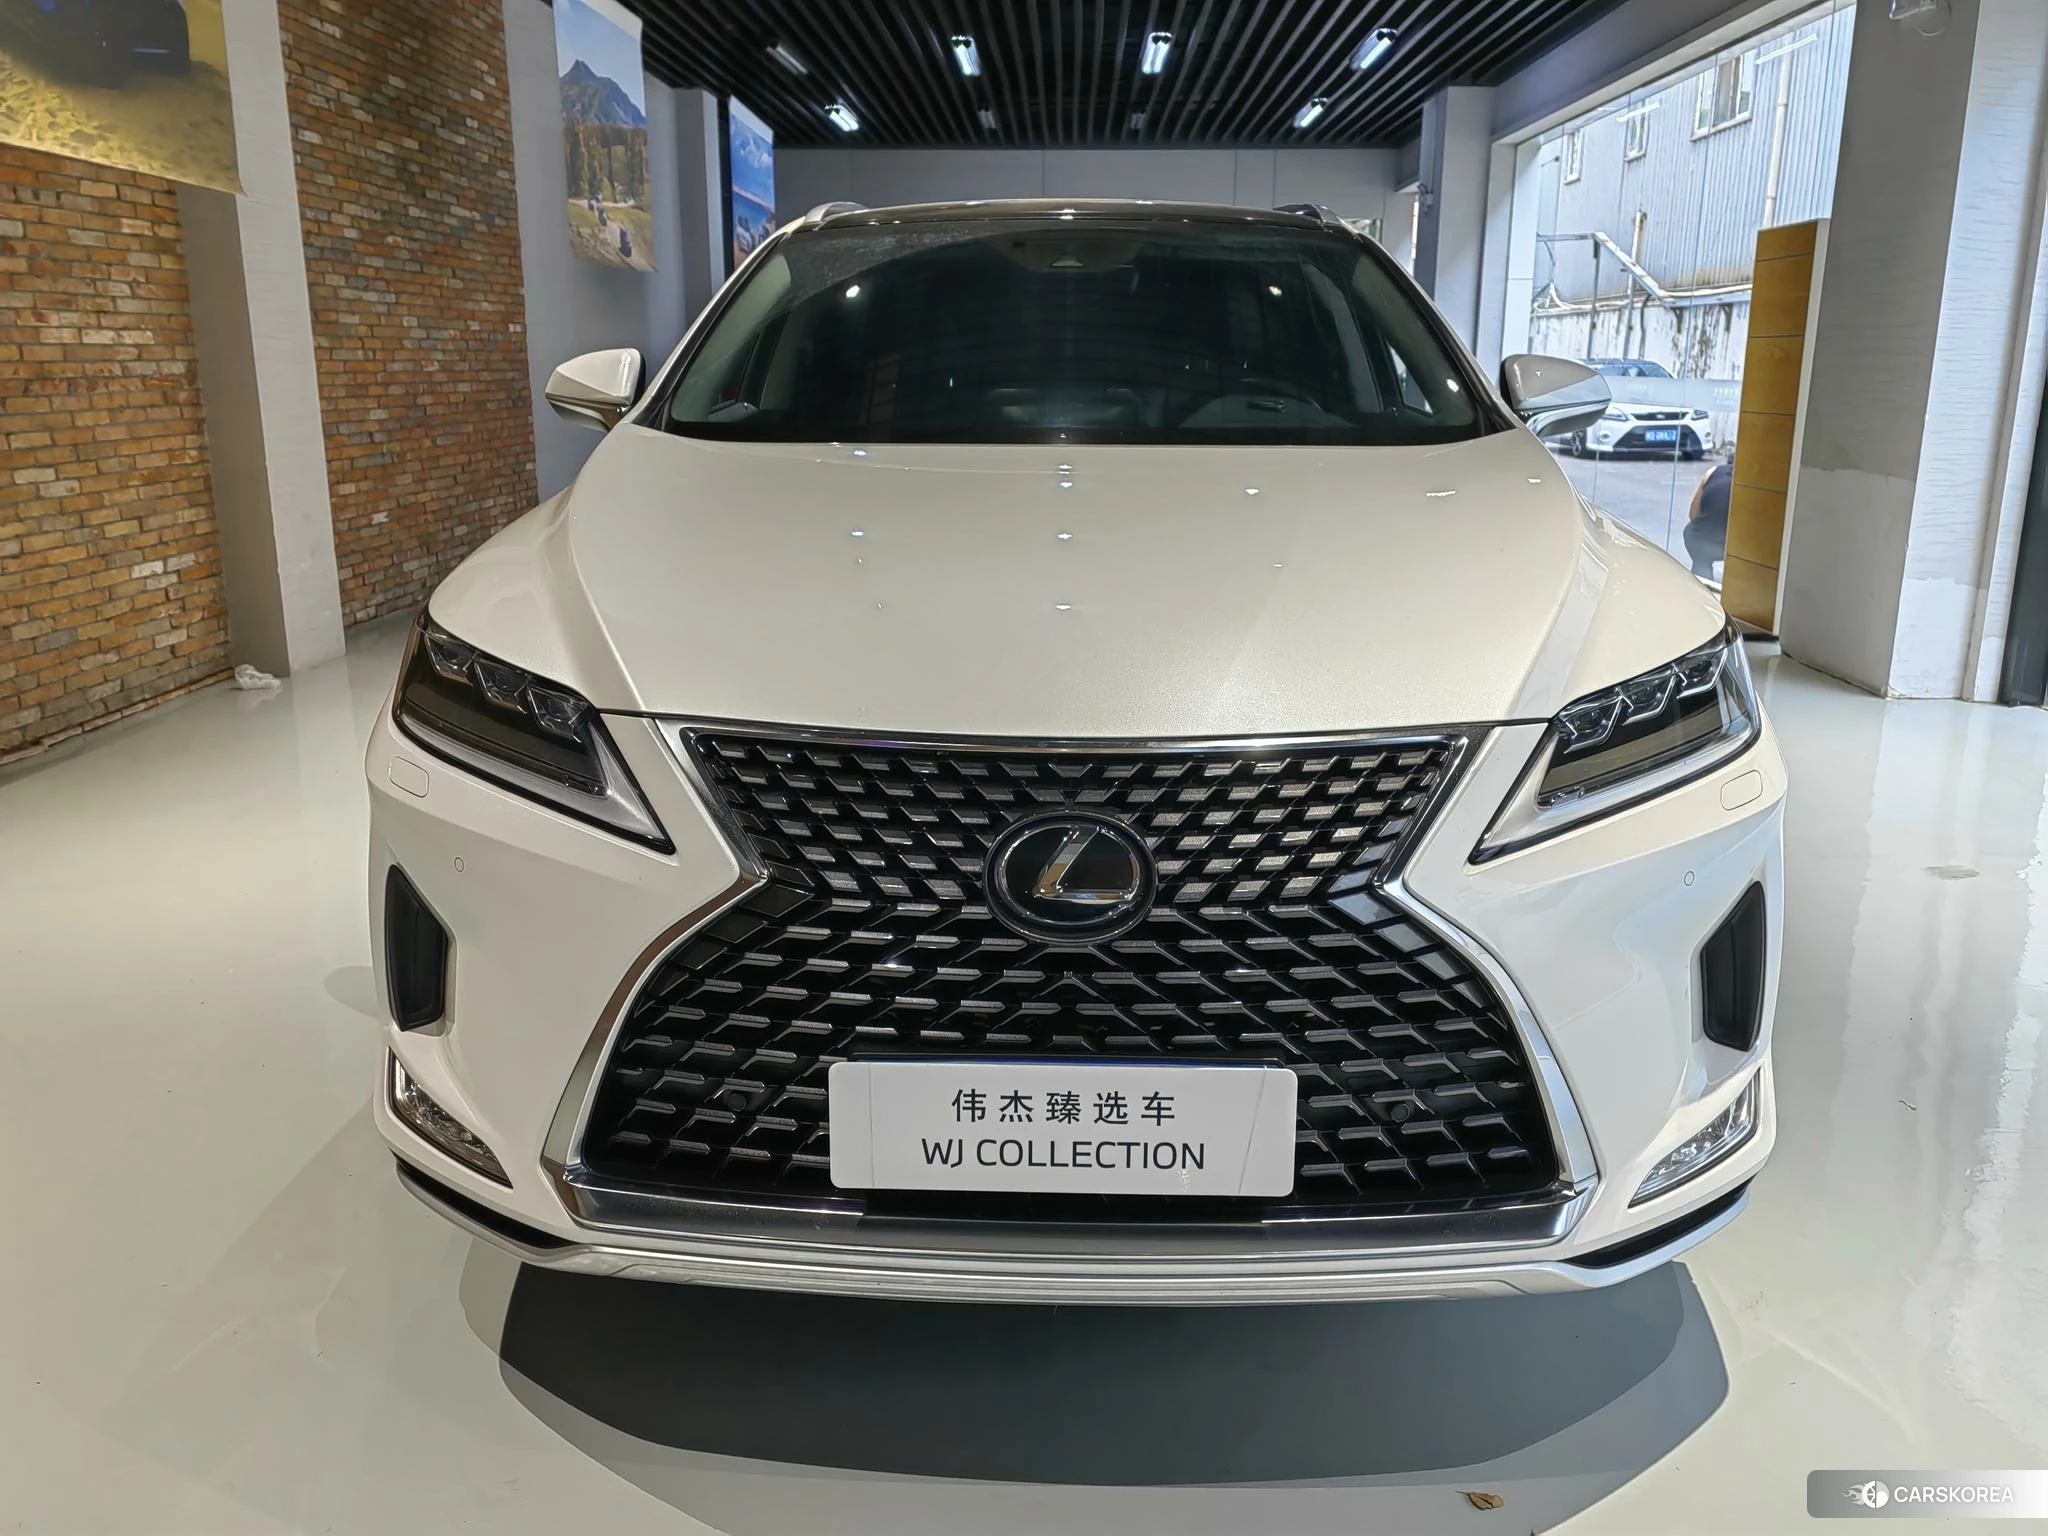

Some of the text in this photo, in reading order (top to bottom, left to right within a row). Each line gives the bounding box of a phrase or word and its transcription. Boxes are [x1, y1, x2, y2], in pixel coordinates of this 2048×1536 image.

[951, 1088, 1176, 1127] 伟杰臻选车
[921, 1138, 1205, 1170] WJ COLLECTION
